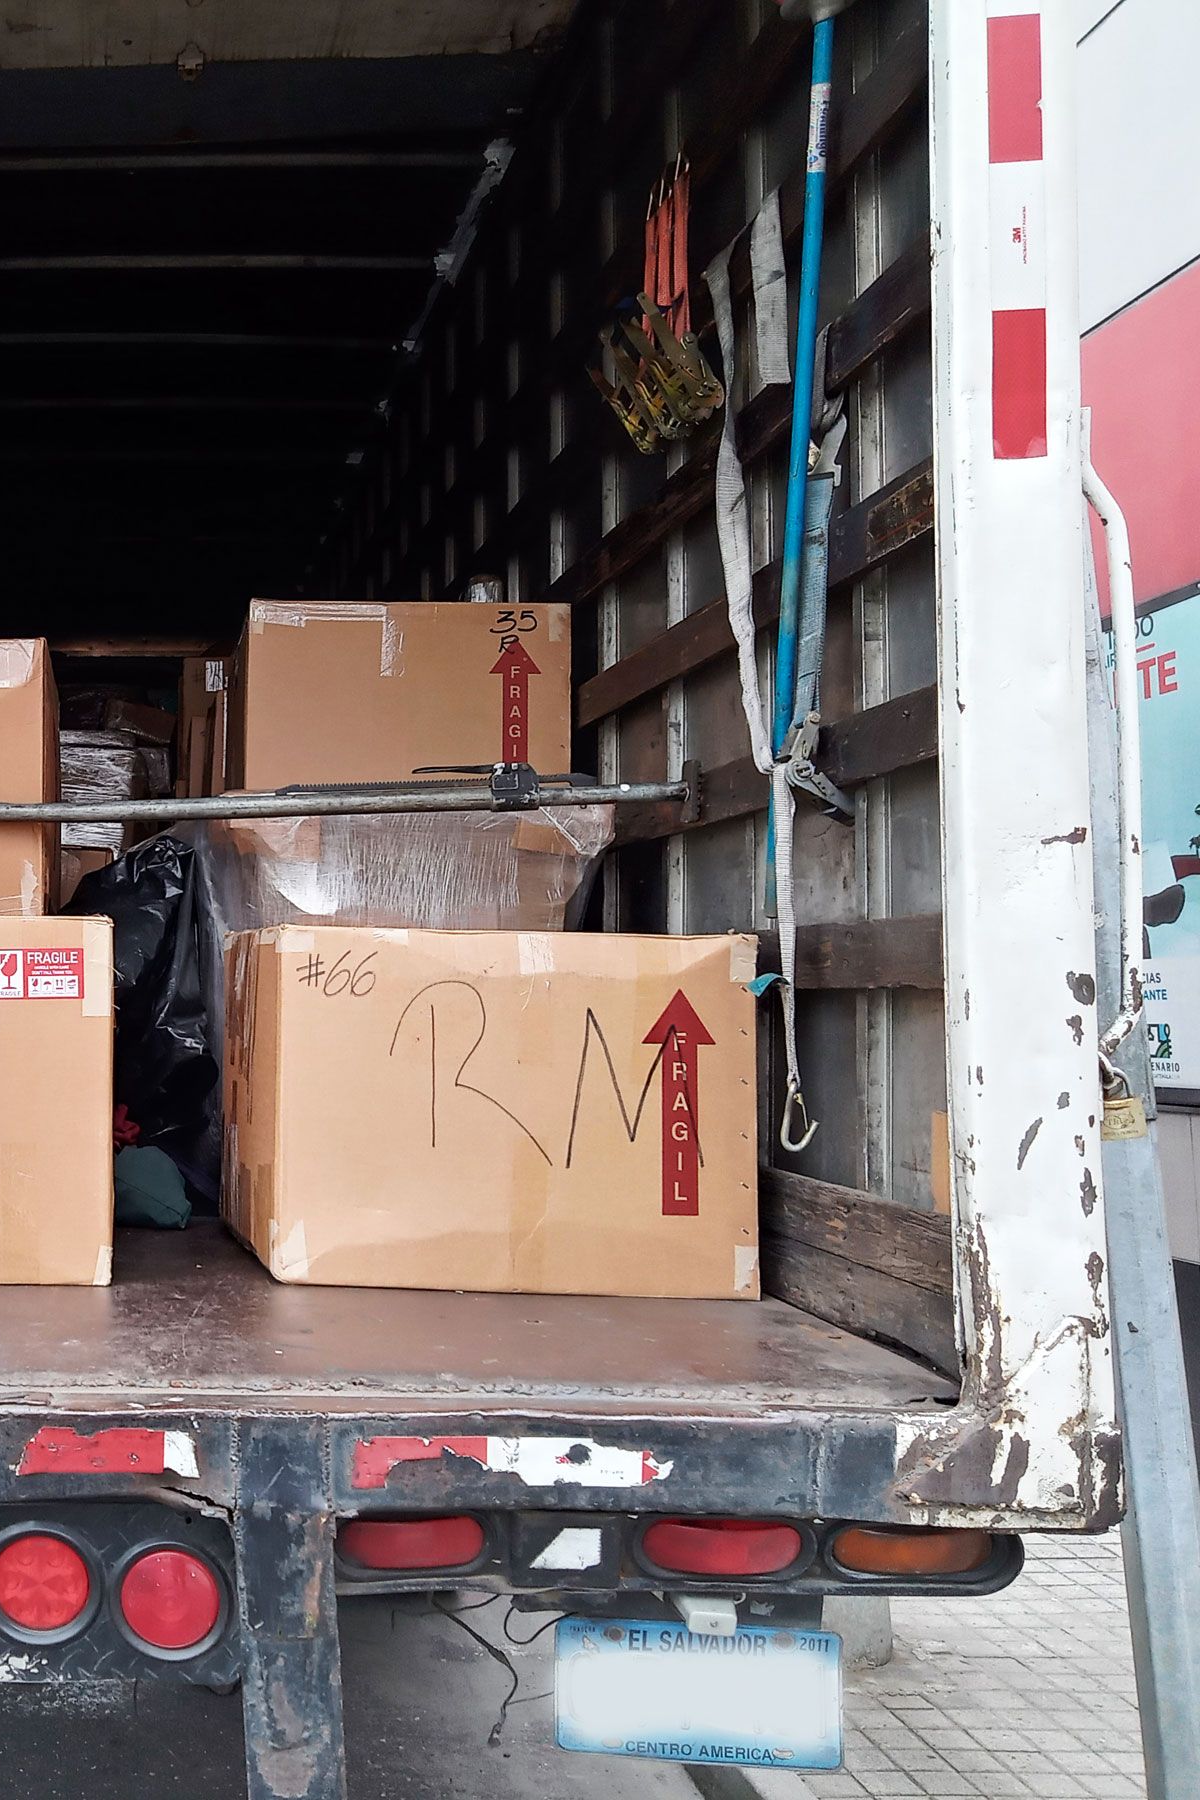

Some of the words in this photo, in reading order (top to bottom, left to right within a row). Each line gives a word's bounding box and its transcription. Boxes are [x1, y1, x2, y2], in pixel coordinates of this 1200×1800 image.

[1012, 227, 1022, 243] 3M
[489, 610, 538, 634] 35
[498, 634, 520, 654] R
[508, 665, 522, 758] FRAGI
[26, 951, 79, 965] FRAGILE
[296, 949, 379, 997] #66
[1142, 973, 1161, 983] CIAS
[1143, 989, 1168, 1000] ANTE
[1150, 1062, 1180, 1073] ENARIO
[671, 1031, 688, 1202] FRAGIL
[628, 1629, 653, 1653] EL
[659, 1629, 767, 1656] SALVADOR
[799, 1637, 830, 1653] 2011
[625, 1740, 693, 1757] CENTRO
[699, 1744, 774, 1762] AMERICA
